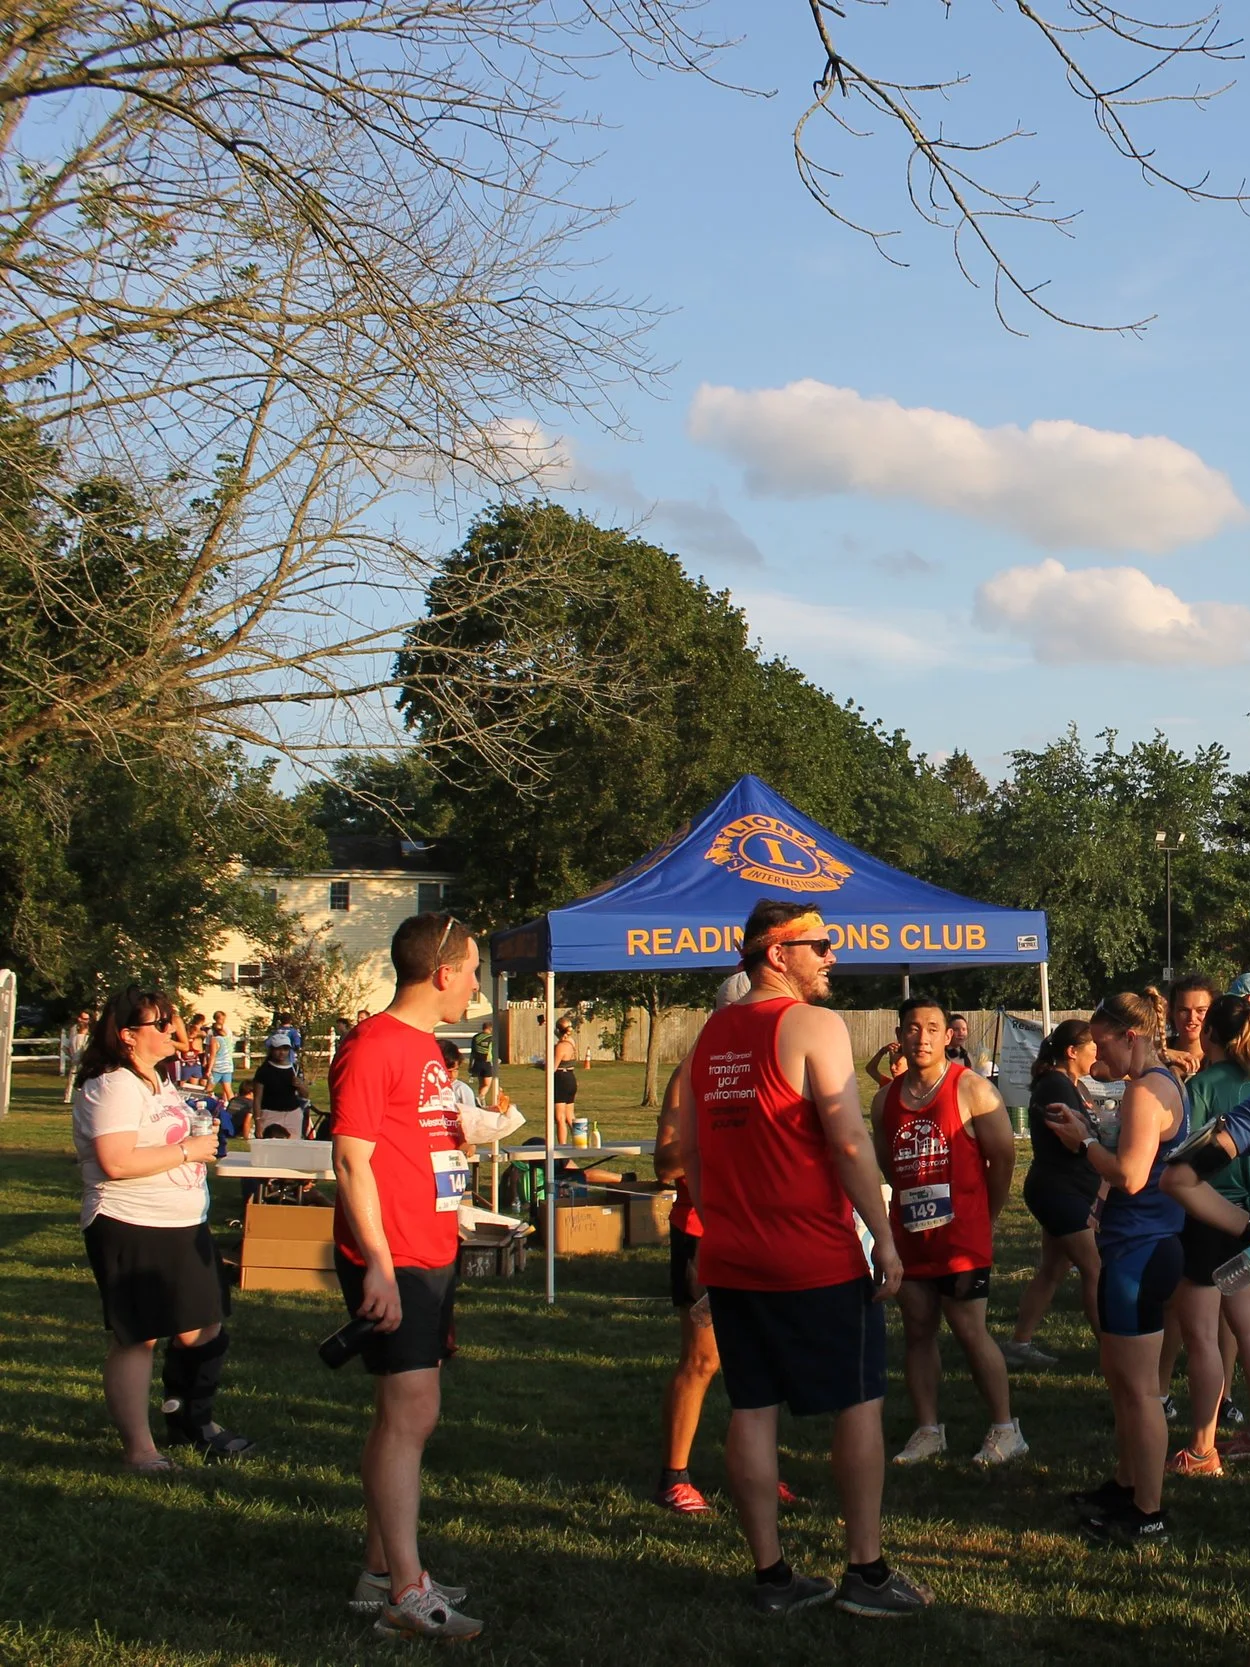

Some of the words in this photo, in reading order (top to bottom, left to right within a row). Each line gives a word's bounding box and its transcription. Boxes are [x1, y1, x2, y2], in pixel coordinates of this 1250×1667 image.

[727, 815, 809, 845] LIONS
[759, 837, 807, 870] L
[627, 925, 746, 957] READI
[823, 923, 891, 951] ONS
[899, 924, 987, 951] CLUB
[910, 1202, 937, 1219] 149
